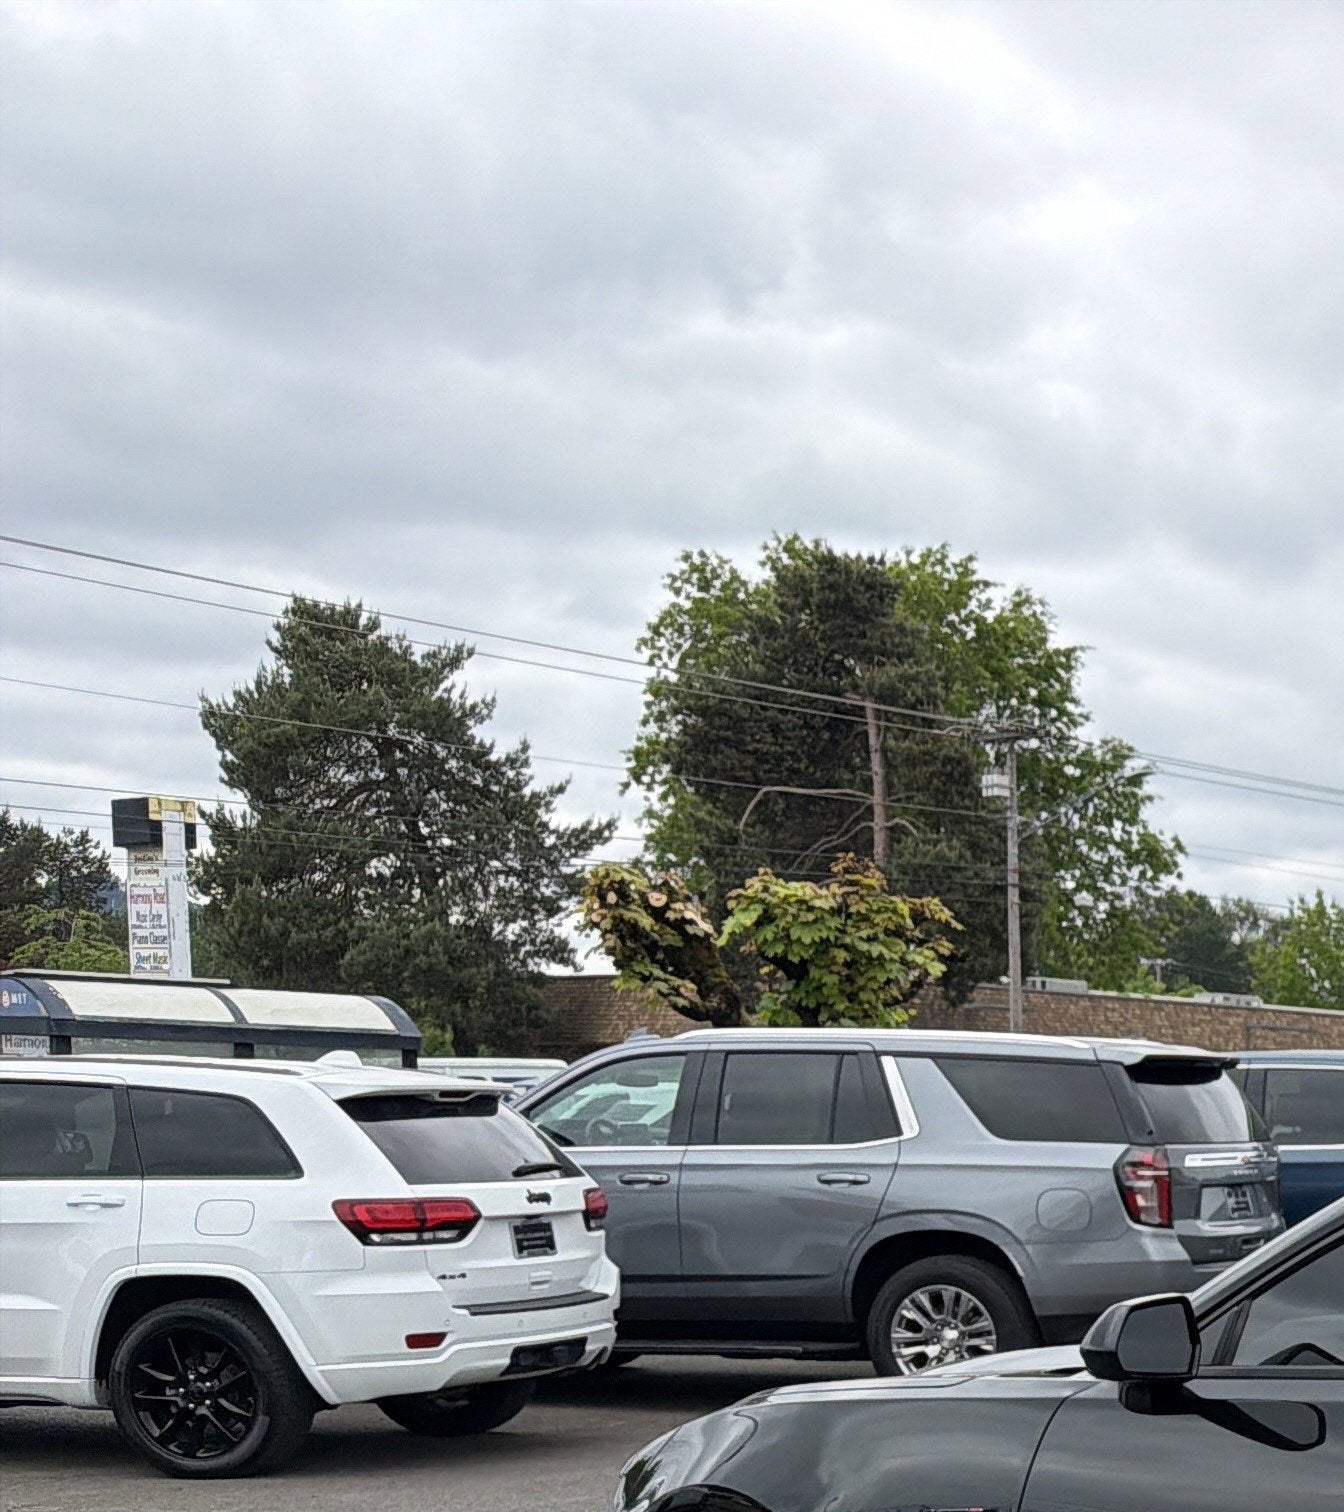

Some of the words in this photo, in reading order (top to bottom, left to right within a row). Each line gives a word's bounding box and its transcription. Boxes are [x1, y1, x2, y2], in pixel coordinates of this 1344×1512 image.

[132, 932, 148, 945] Piano
[136, 952, 151, 965] Sheet
[153, 952, 168, 965] Music
[4, 1035, 50, 1049] Harmon
